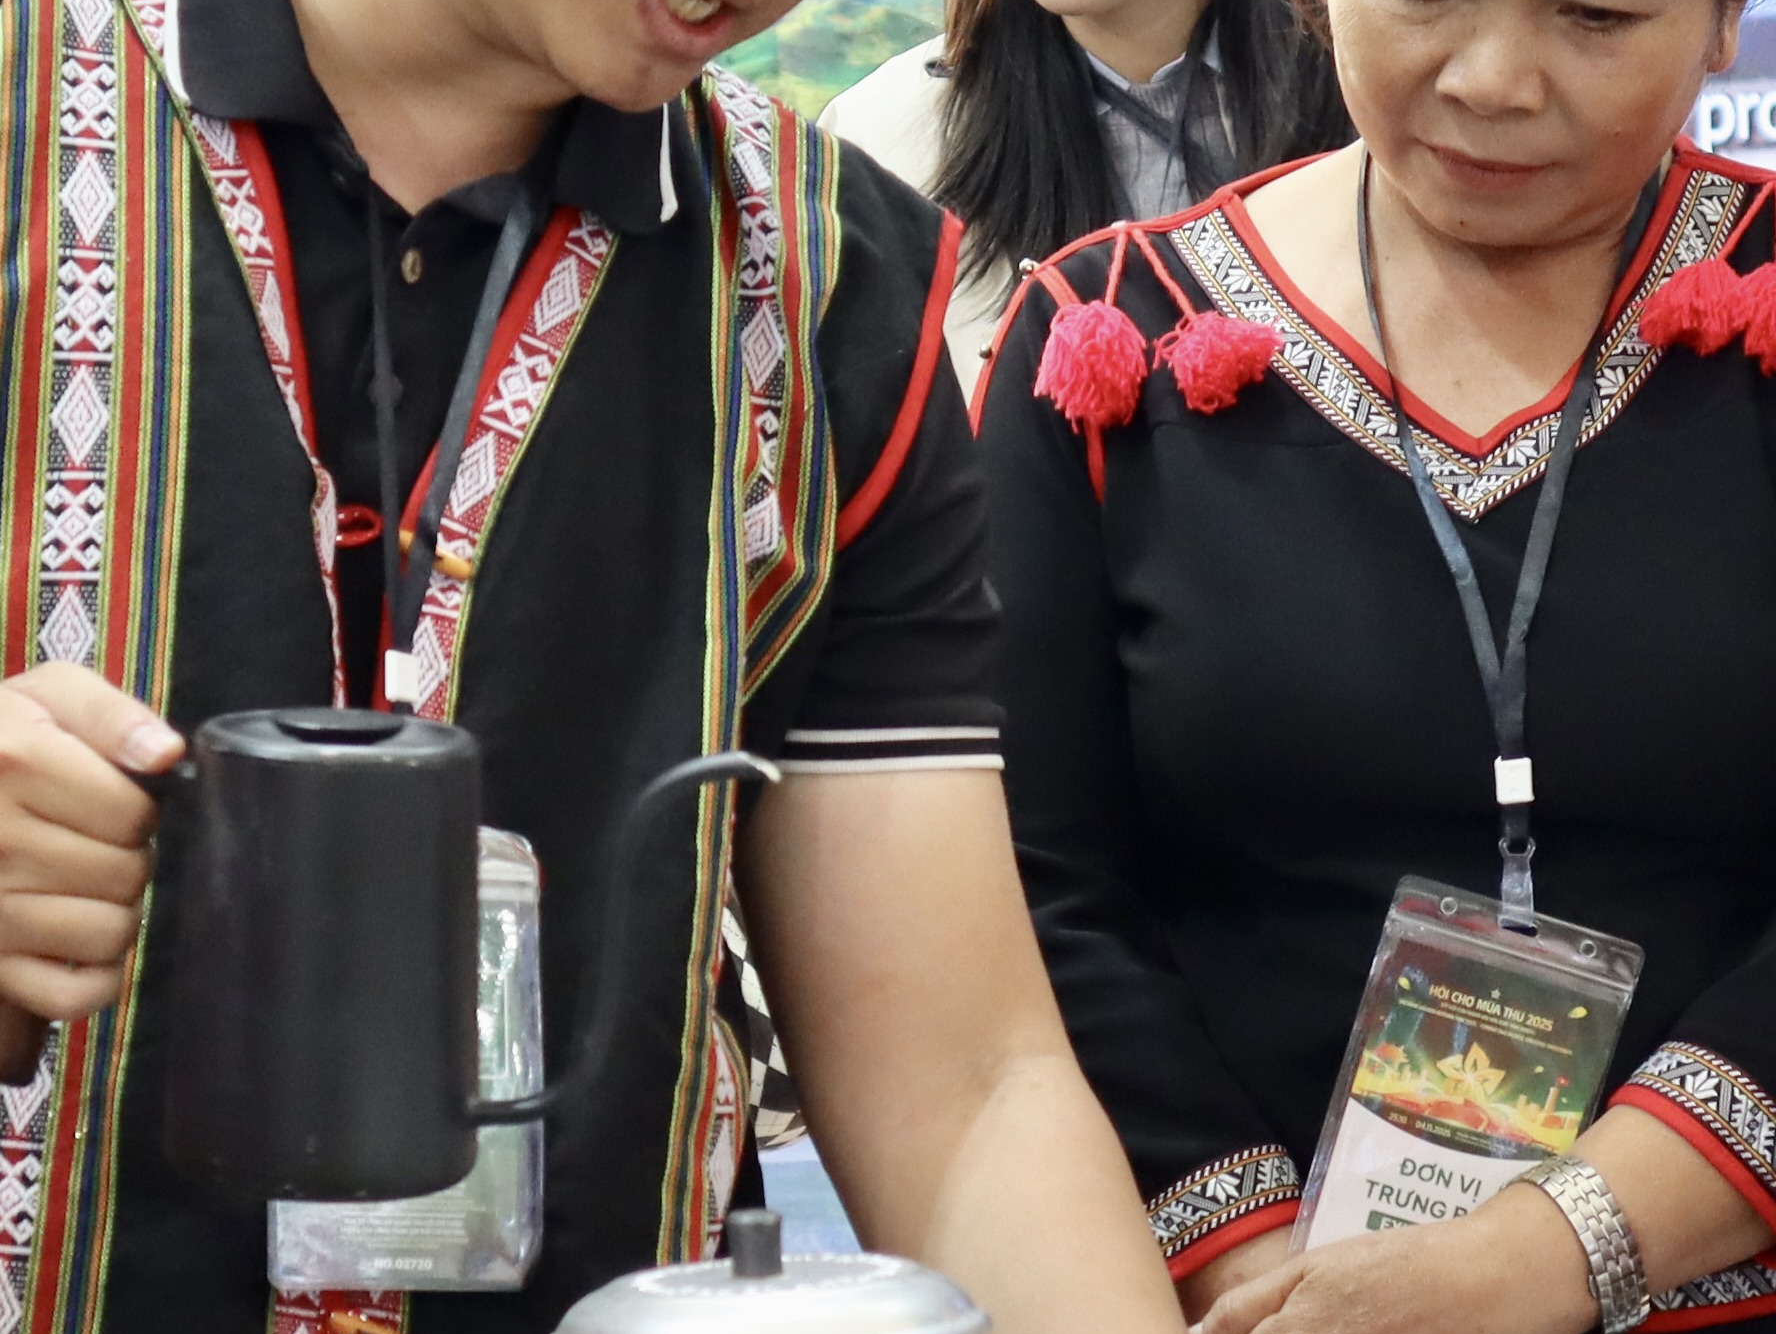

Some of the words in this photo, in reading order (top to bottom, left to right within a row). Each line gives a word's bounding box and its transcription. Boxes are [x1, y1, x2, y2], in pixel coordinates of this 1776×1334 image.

[1429, 984, 1450, 1000] HỘI
[1451, 991, 1475, 1008] CHỢ
[1476, 997, 1502, 1016] MÙA
[1503, 1005, 1525, 1023] THU
[1525, 1013, 1554, 1032] 2025
[1365, 1179, 1447, 1218] TRƯNG
[1399, 1157, 1453, 1188] ĐƠN
[1460, 1174, 1482, 1203] VỊ
